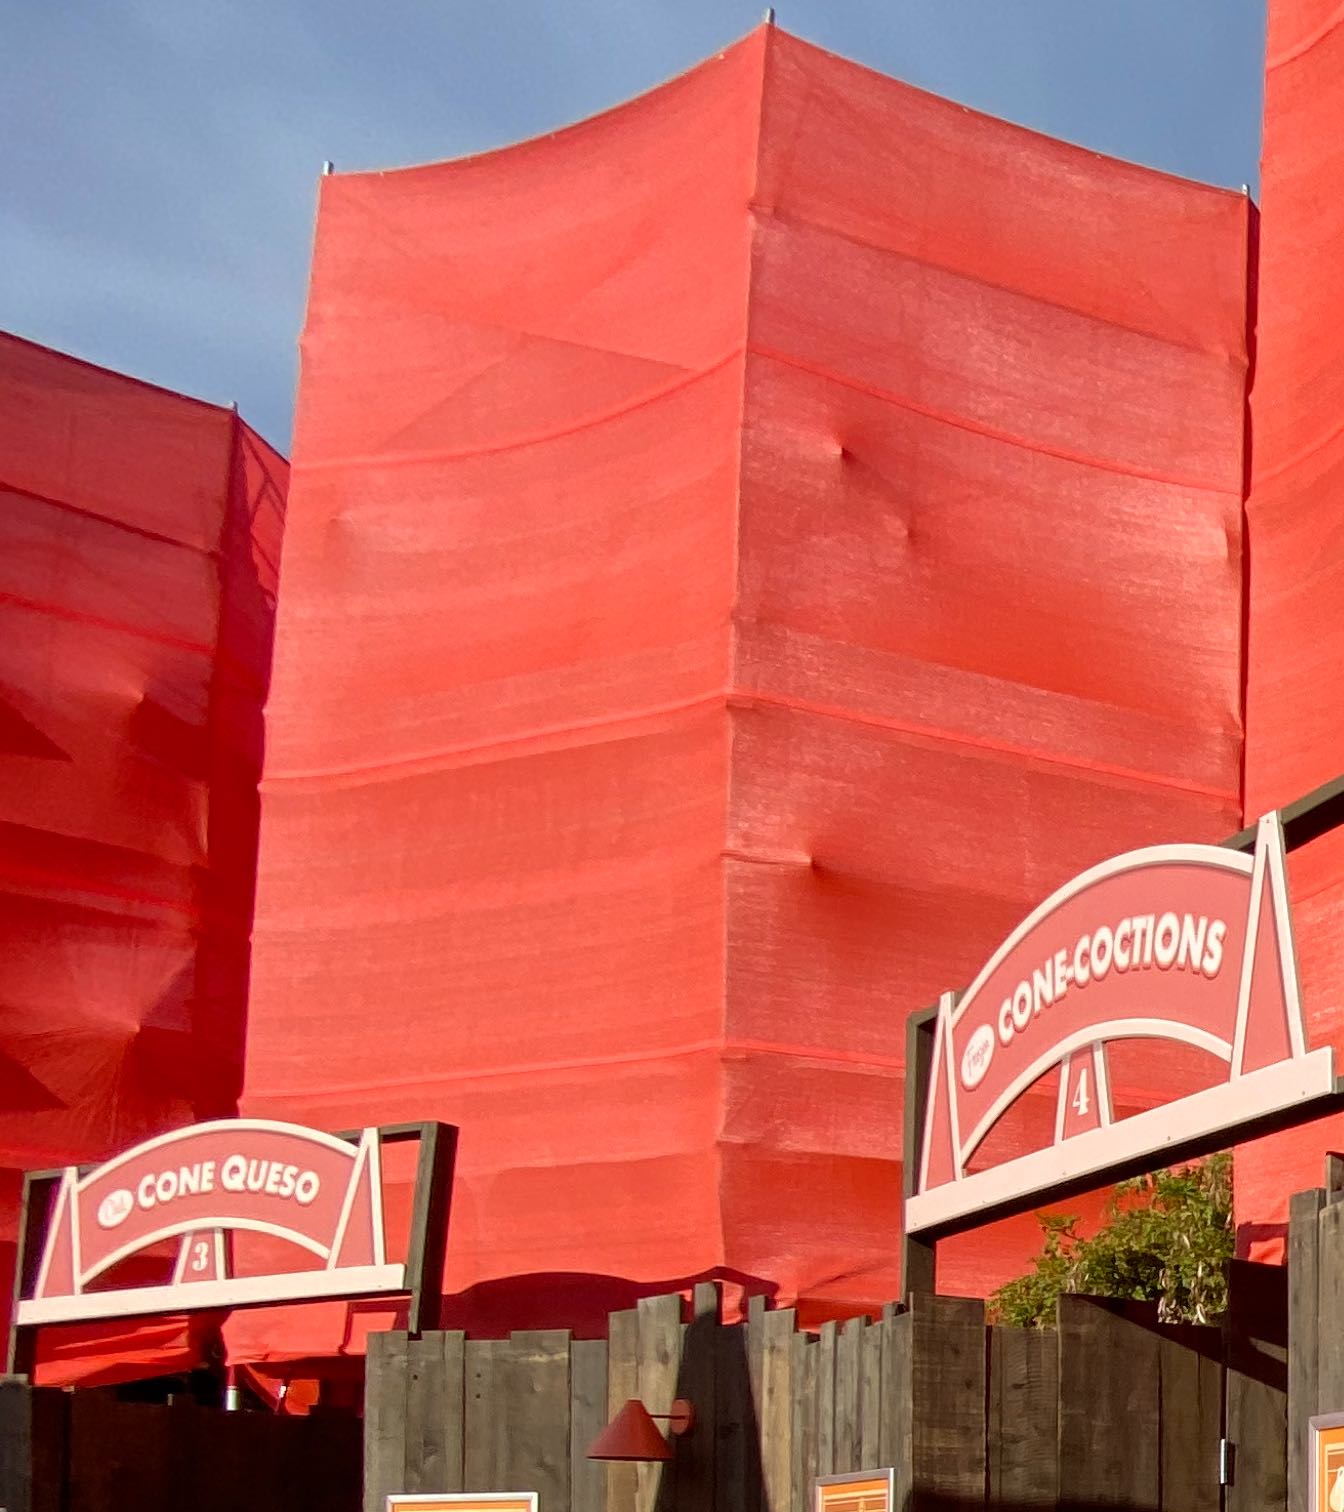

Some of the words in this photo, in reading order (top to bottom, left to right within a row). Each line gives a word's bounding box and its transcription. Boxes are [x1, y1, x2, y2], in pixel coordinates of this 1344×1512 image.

[998, 912, 1227, 1047] CONE-COCTIONS
[1071, 1067, 1090, 1117] 4
[137, 1161, 216, 1209] CONE
[220, 1153, 321, 1205] QUESO
[191, 1241, 209, 1272] 3
